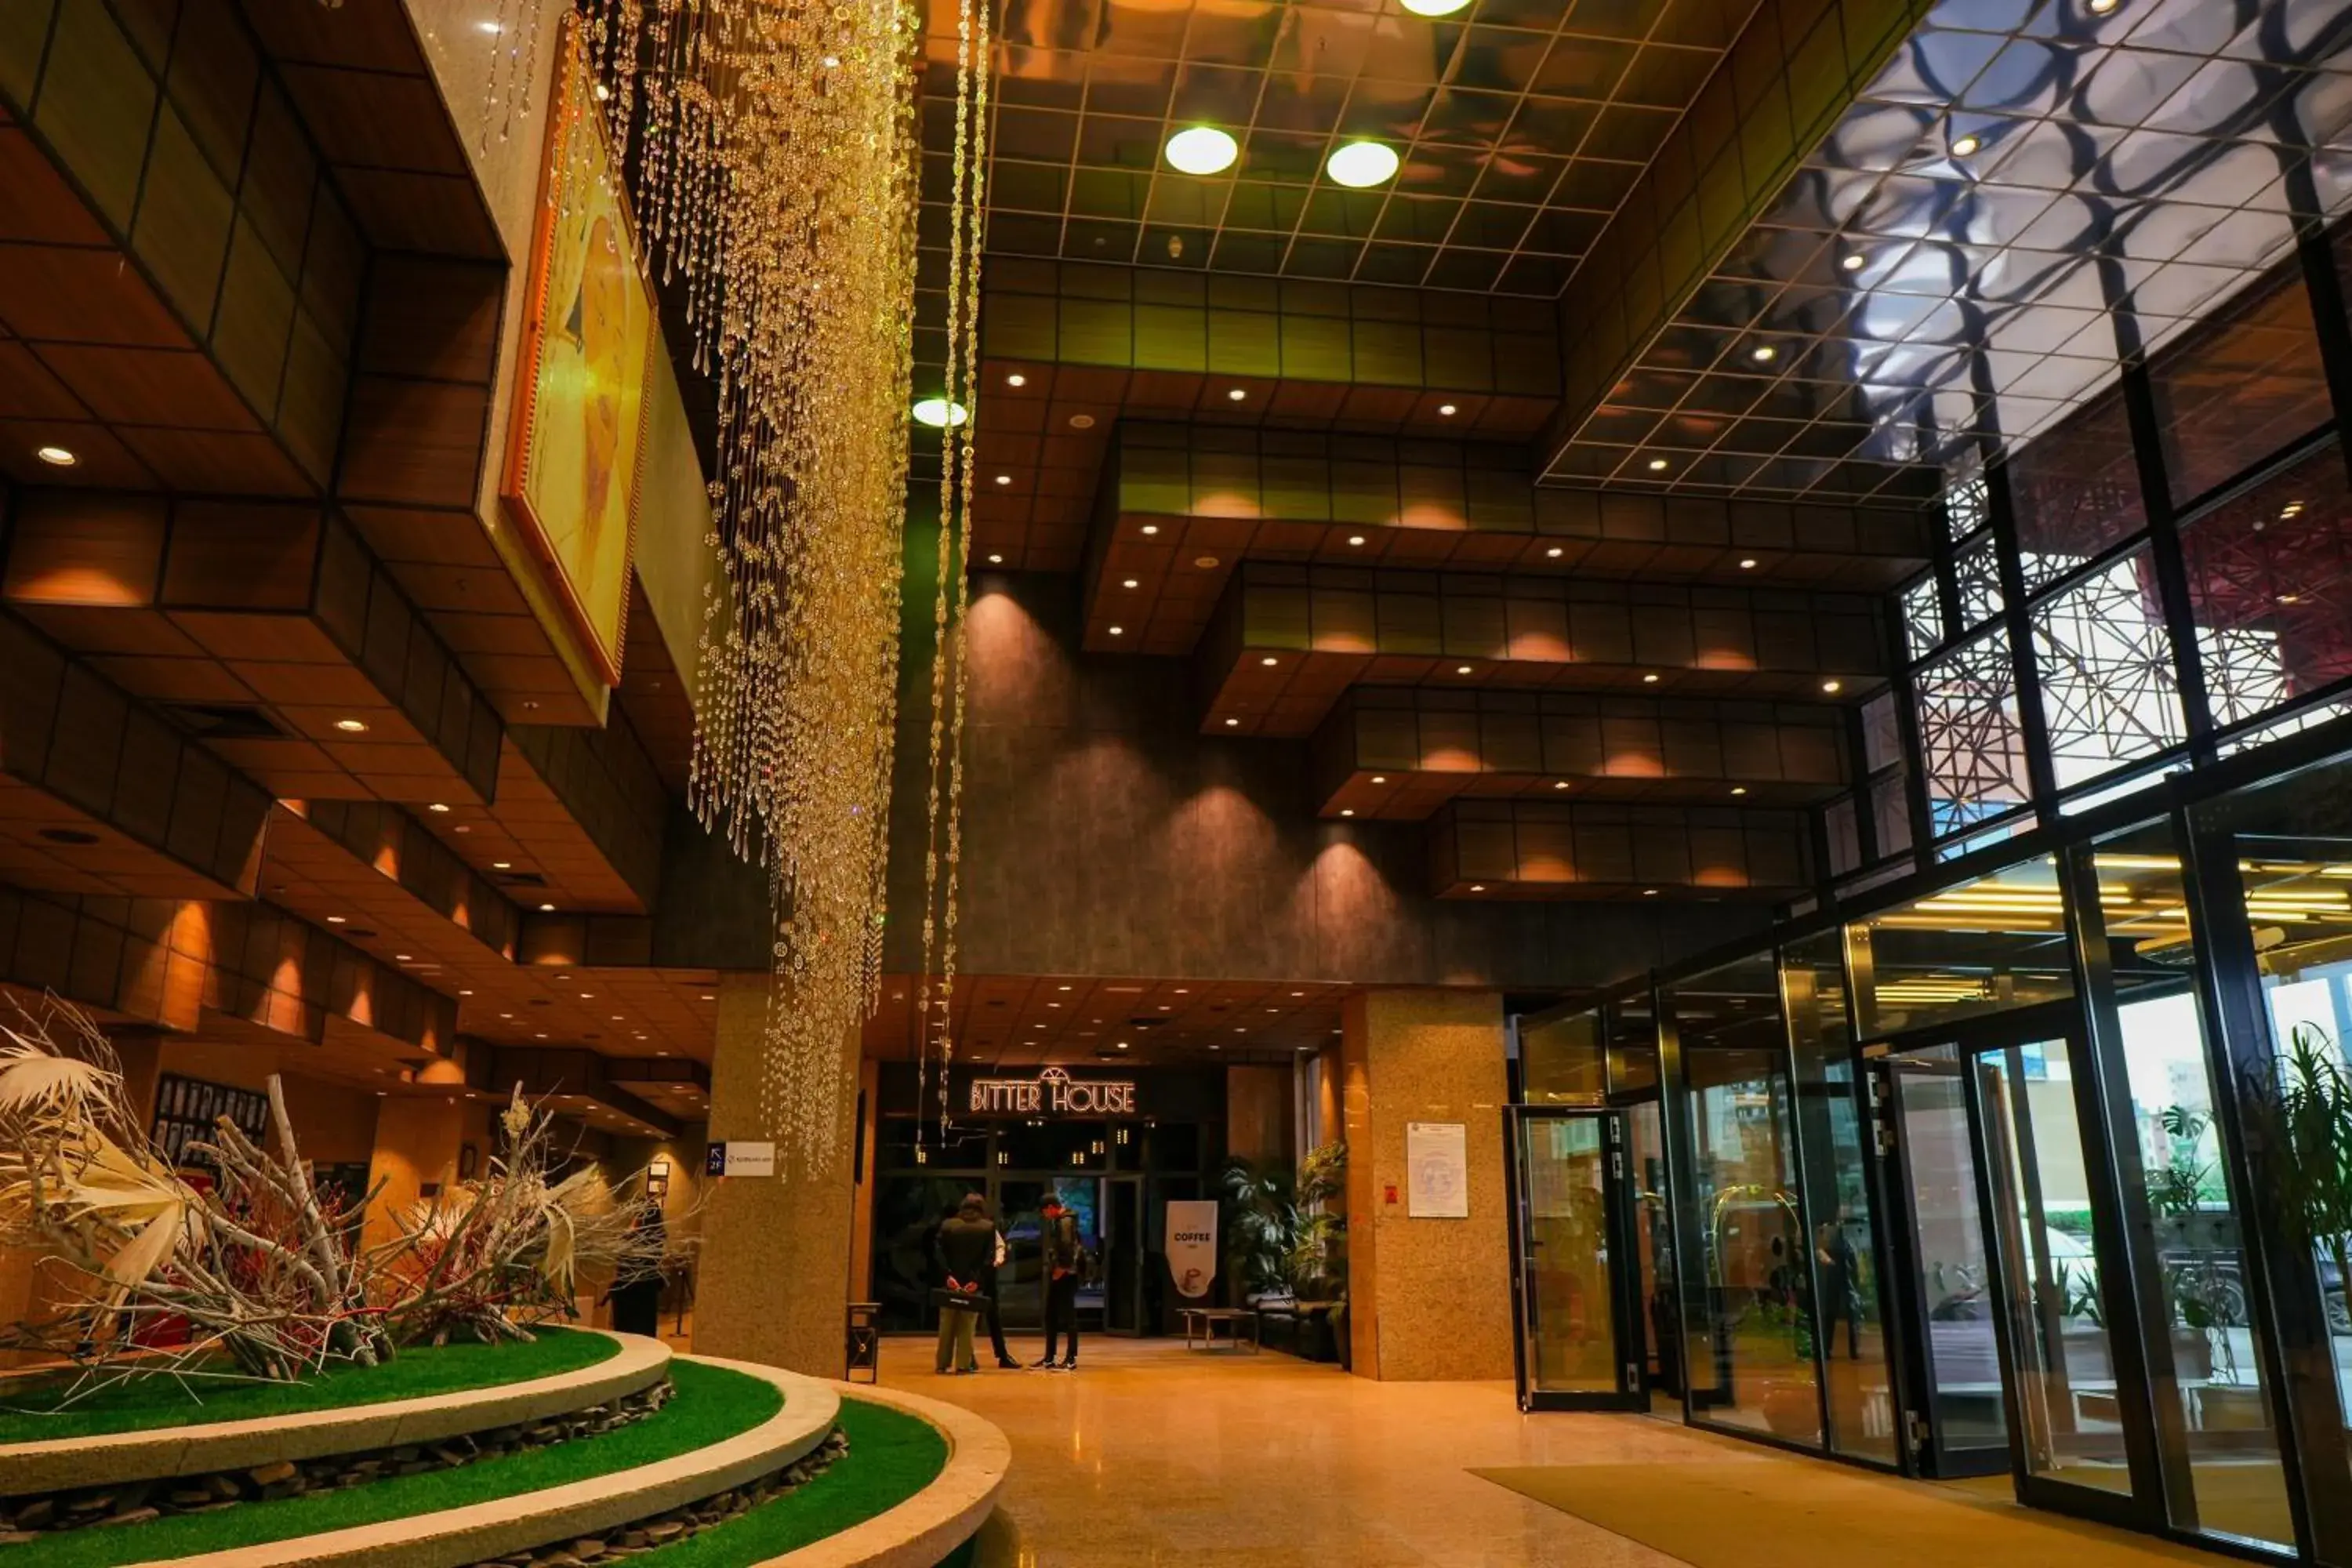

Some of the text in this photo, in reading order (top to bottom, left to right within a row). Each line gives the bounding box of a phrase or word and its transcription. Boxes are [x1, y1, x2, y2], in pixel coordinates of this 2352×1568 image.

[971, 1085, 1135, 1112] BITTER HOUSE
[1174, 1232, 1210, 1242] COFFEE
